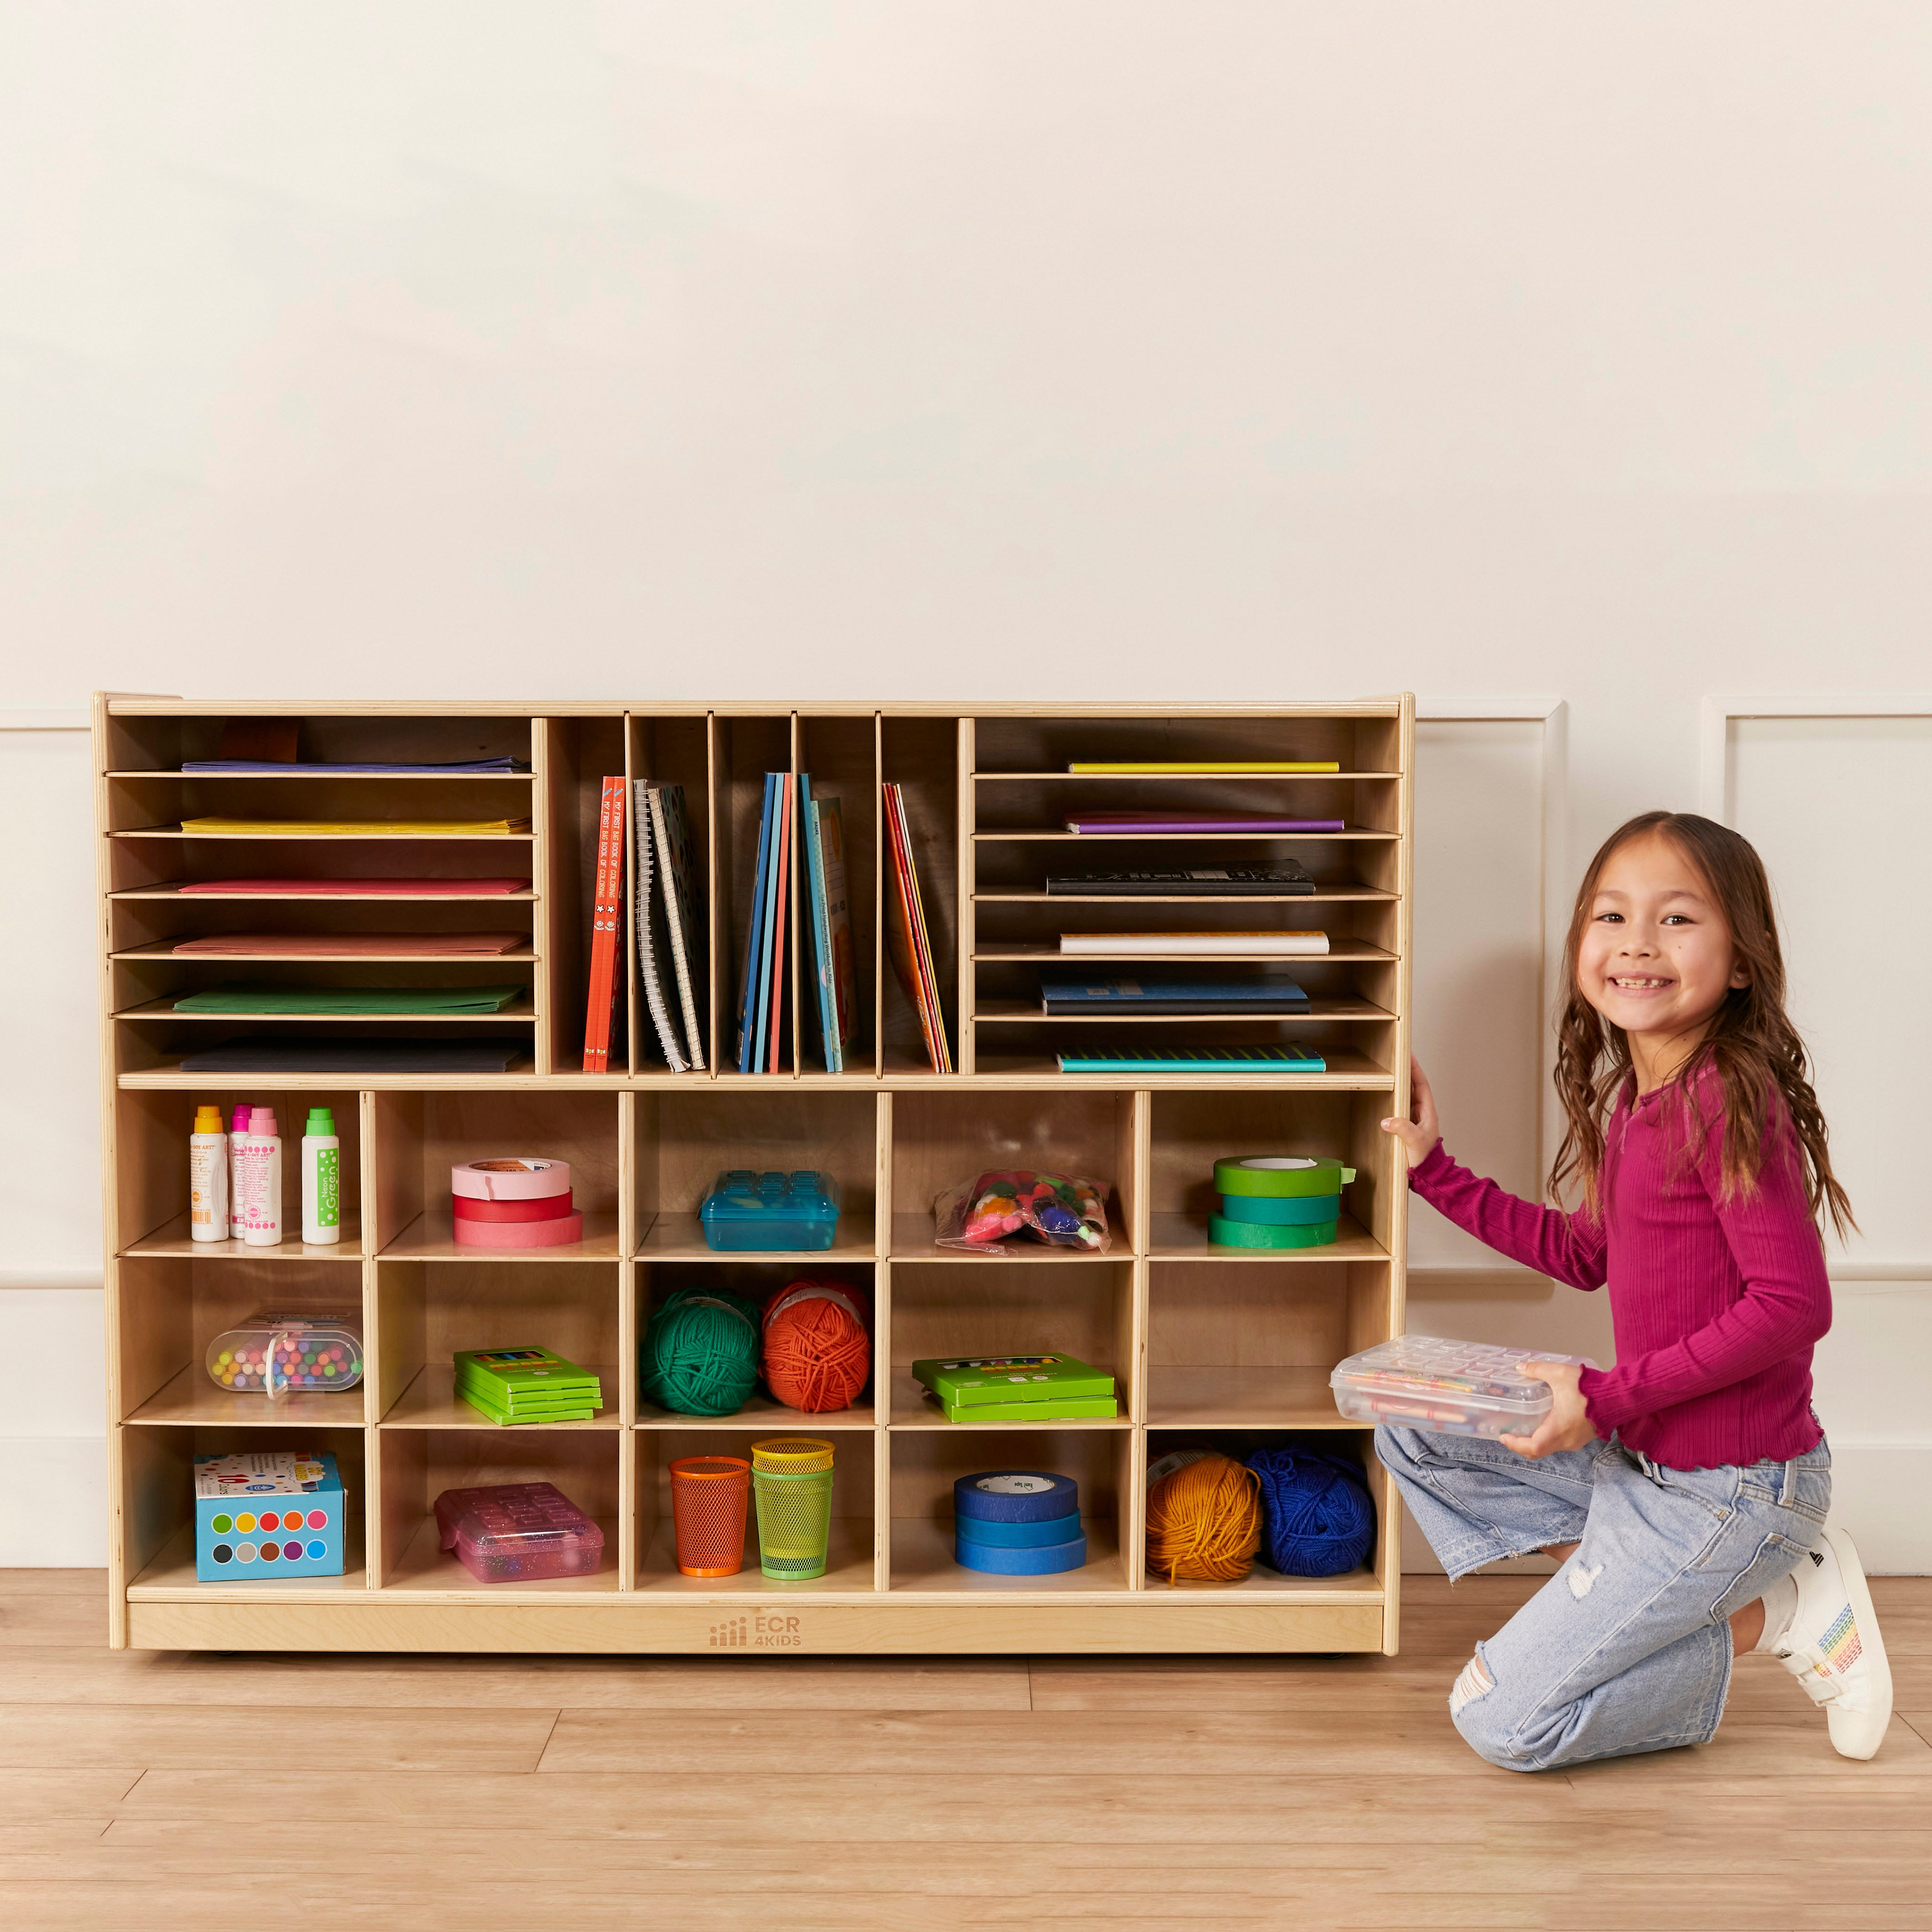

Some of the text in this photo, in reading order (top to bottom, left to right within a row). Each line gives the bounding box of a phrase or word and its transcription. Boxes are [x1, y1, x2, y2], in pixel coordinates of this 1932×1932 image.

[604, 801, 610, 810] MY
[615, 801, 621, 810] MY
[600, 859, 607, 868] OF
[611, 860, 617, 868] OF
[326, 1166, 336, 1208] Green
[217, 1474, 250, 1484] 10
[755, 1617, 800, 1633] ECR
[754, 1635, 801, 1646] 4KIDS
